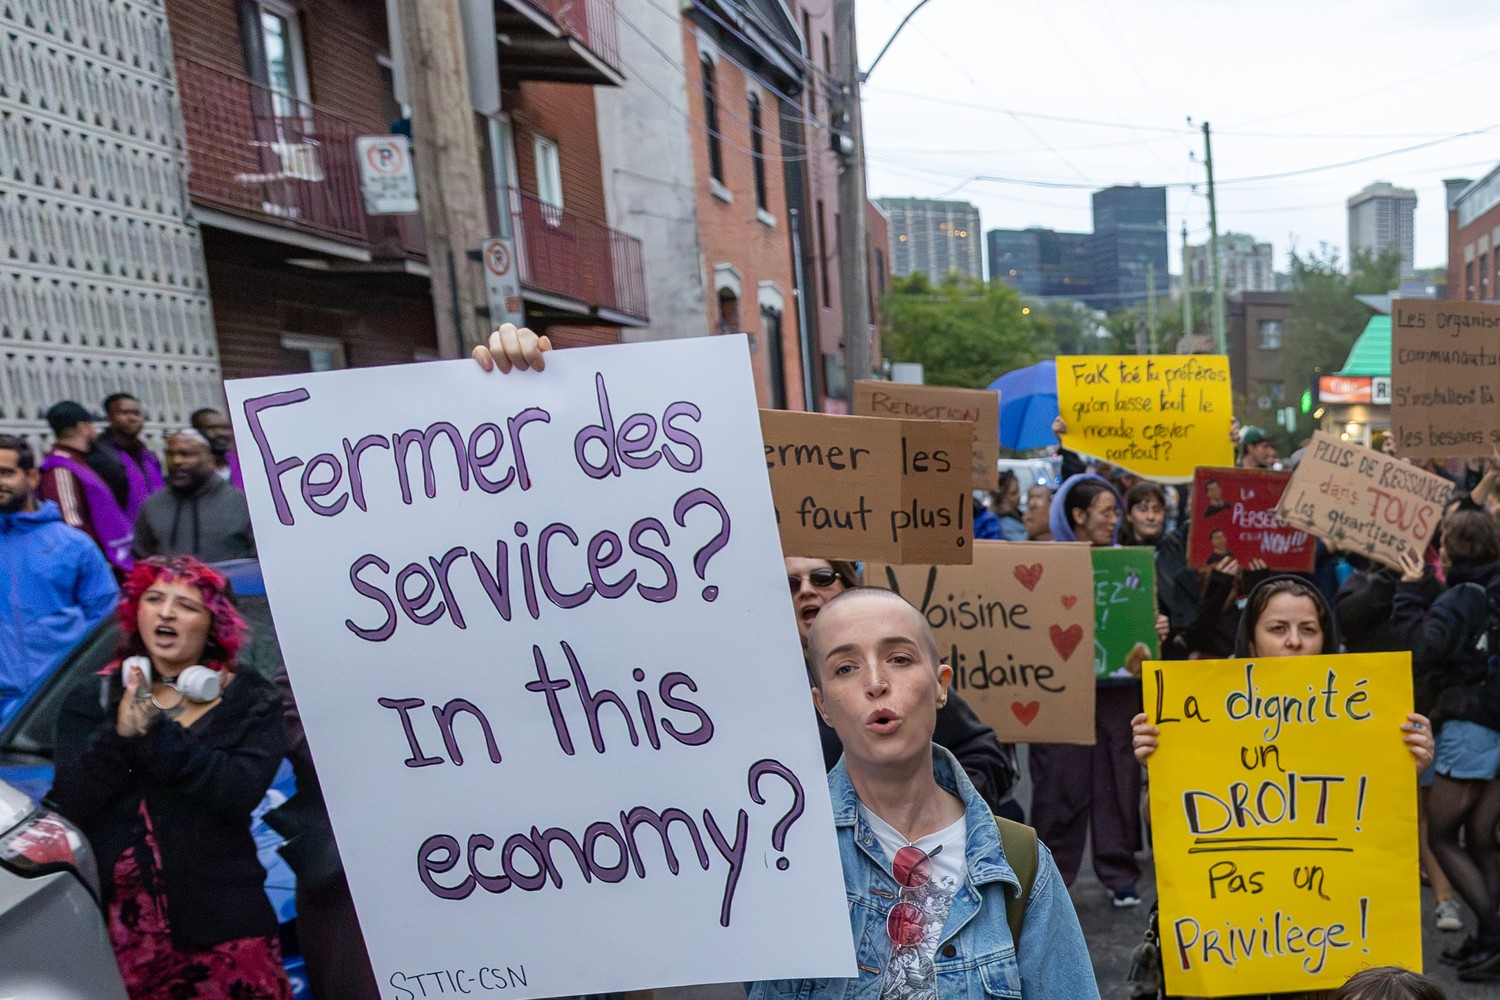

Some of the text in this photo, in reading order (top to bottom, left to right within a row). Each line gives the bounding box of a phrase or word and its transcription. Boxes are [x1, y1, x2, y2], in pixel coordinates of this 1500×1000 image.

[1146, 359, 1160, 382] tu
[1159, 387, 1187, 413] tout
[1197, 388, 1215, 414] le
[243, 371, 704, 526] Fermer des
[901, 437, 951, 476] les
[1312, 440, 1353, 469] PLUS
[1357, 455, 1379, 478] DE
[796, 493, 966, 548] faut plus!
[1293, 490, 1316, 518] les
[1367, 486, 1435, 541] TOUS
[345, 487, 732, 642] services?
[885, 565, 1031, 630] Voisine
[940, 643, 1066, 693] lidaire
[377, 640, 715, 768] In this
[1154, 663, 1372, 743] La dignité
[1240, 744, 1286, 773] un
[416, 758, 806, 928] economy?
[1208, 860, 1332, 902] Pas un
